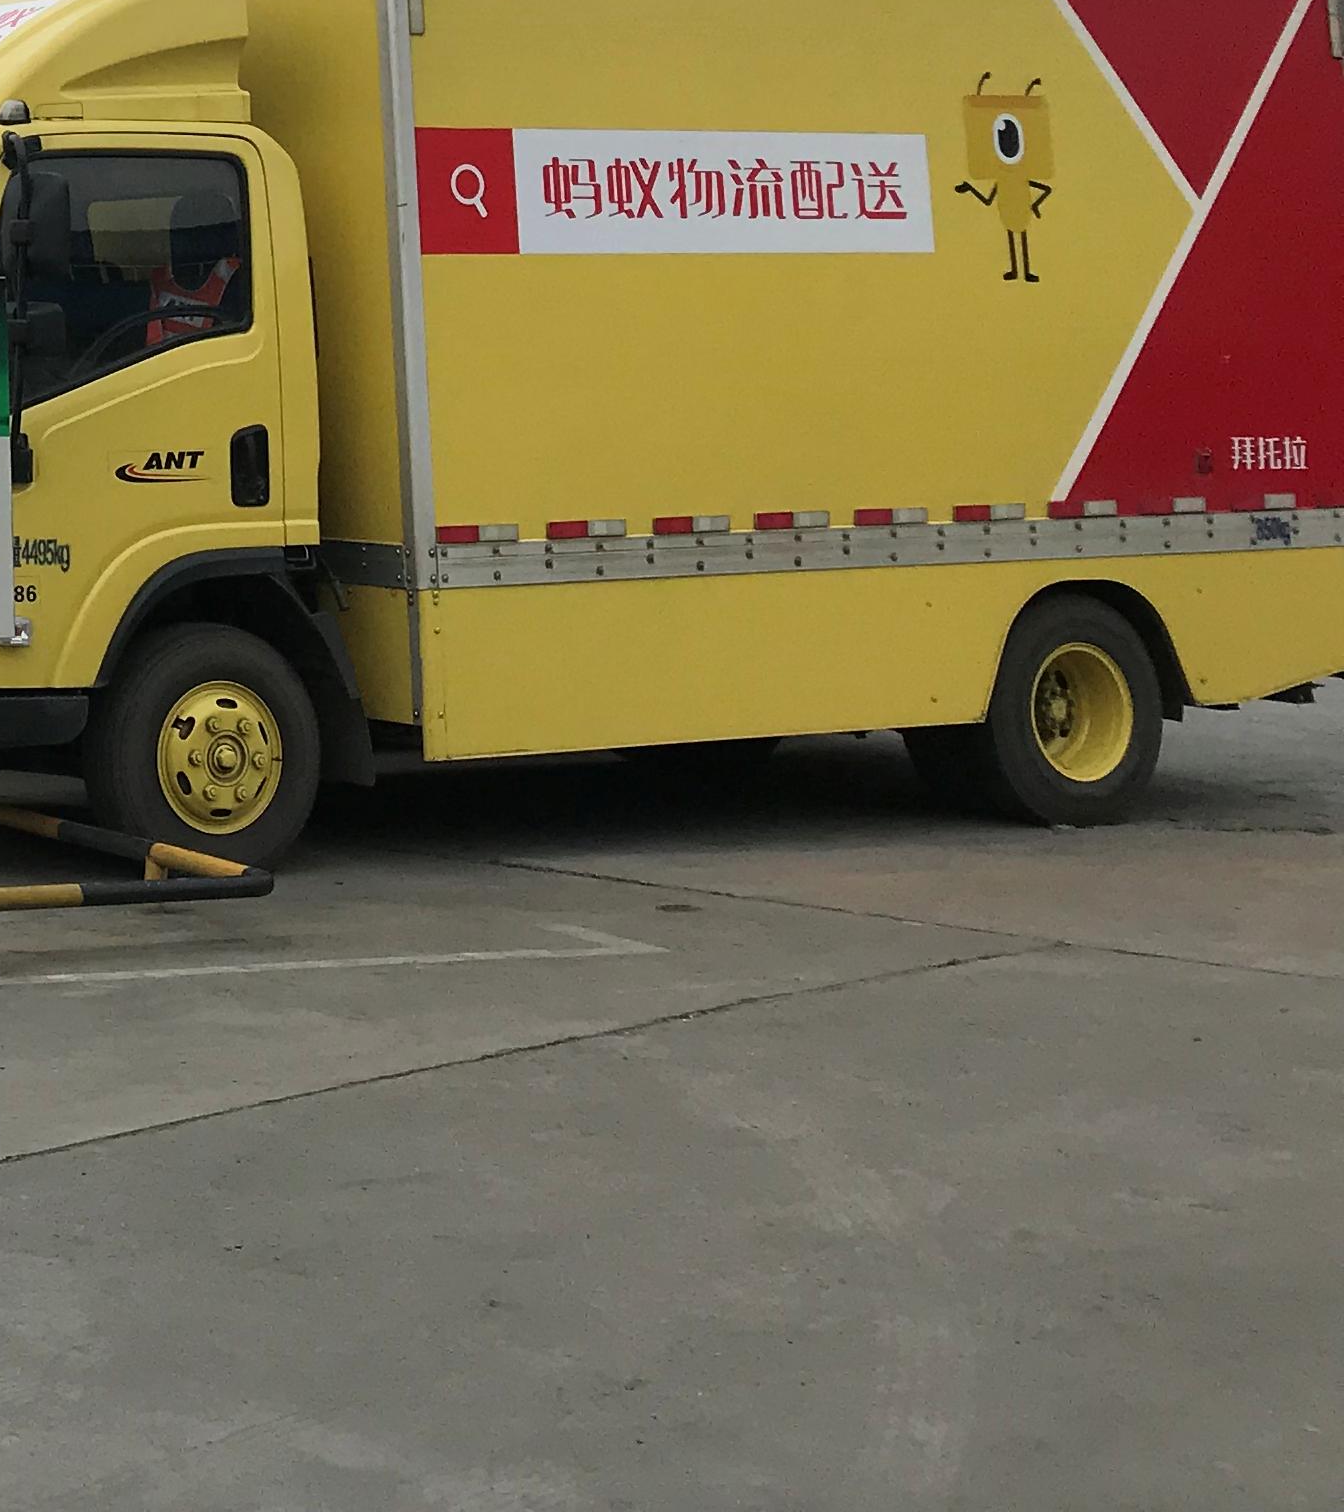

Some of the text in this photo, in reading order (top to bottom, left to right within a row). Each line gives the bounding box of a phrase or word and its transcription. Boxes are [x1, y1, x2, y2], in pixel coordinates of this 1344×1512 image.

[543, 156, 908, 220] 蚂蚁物流配送
[142, 450, 205, 470] ANT
